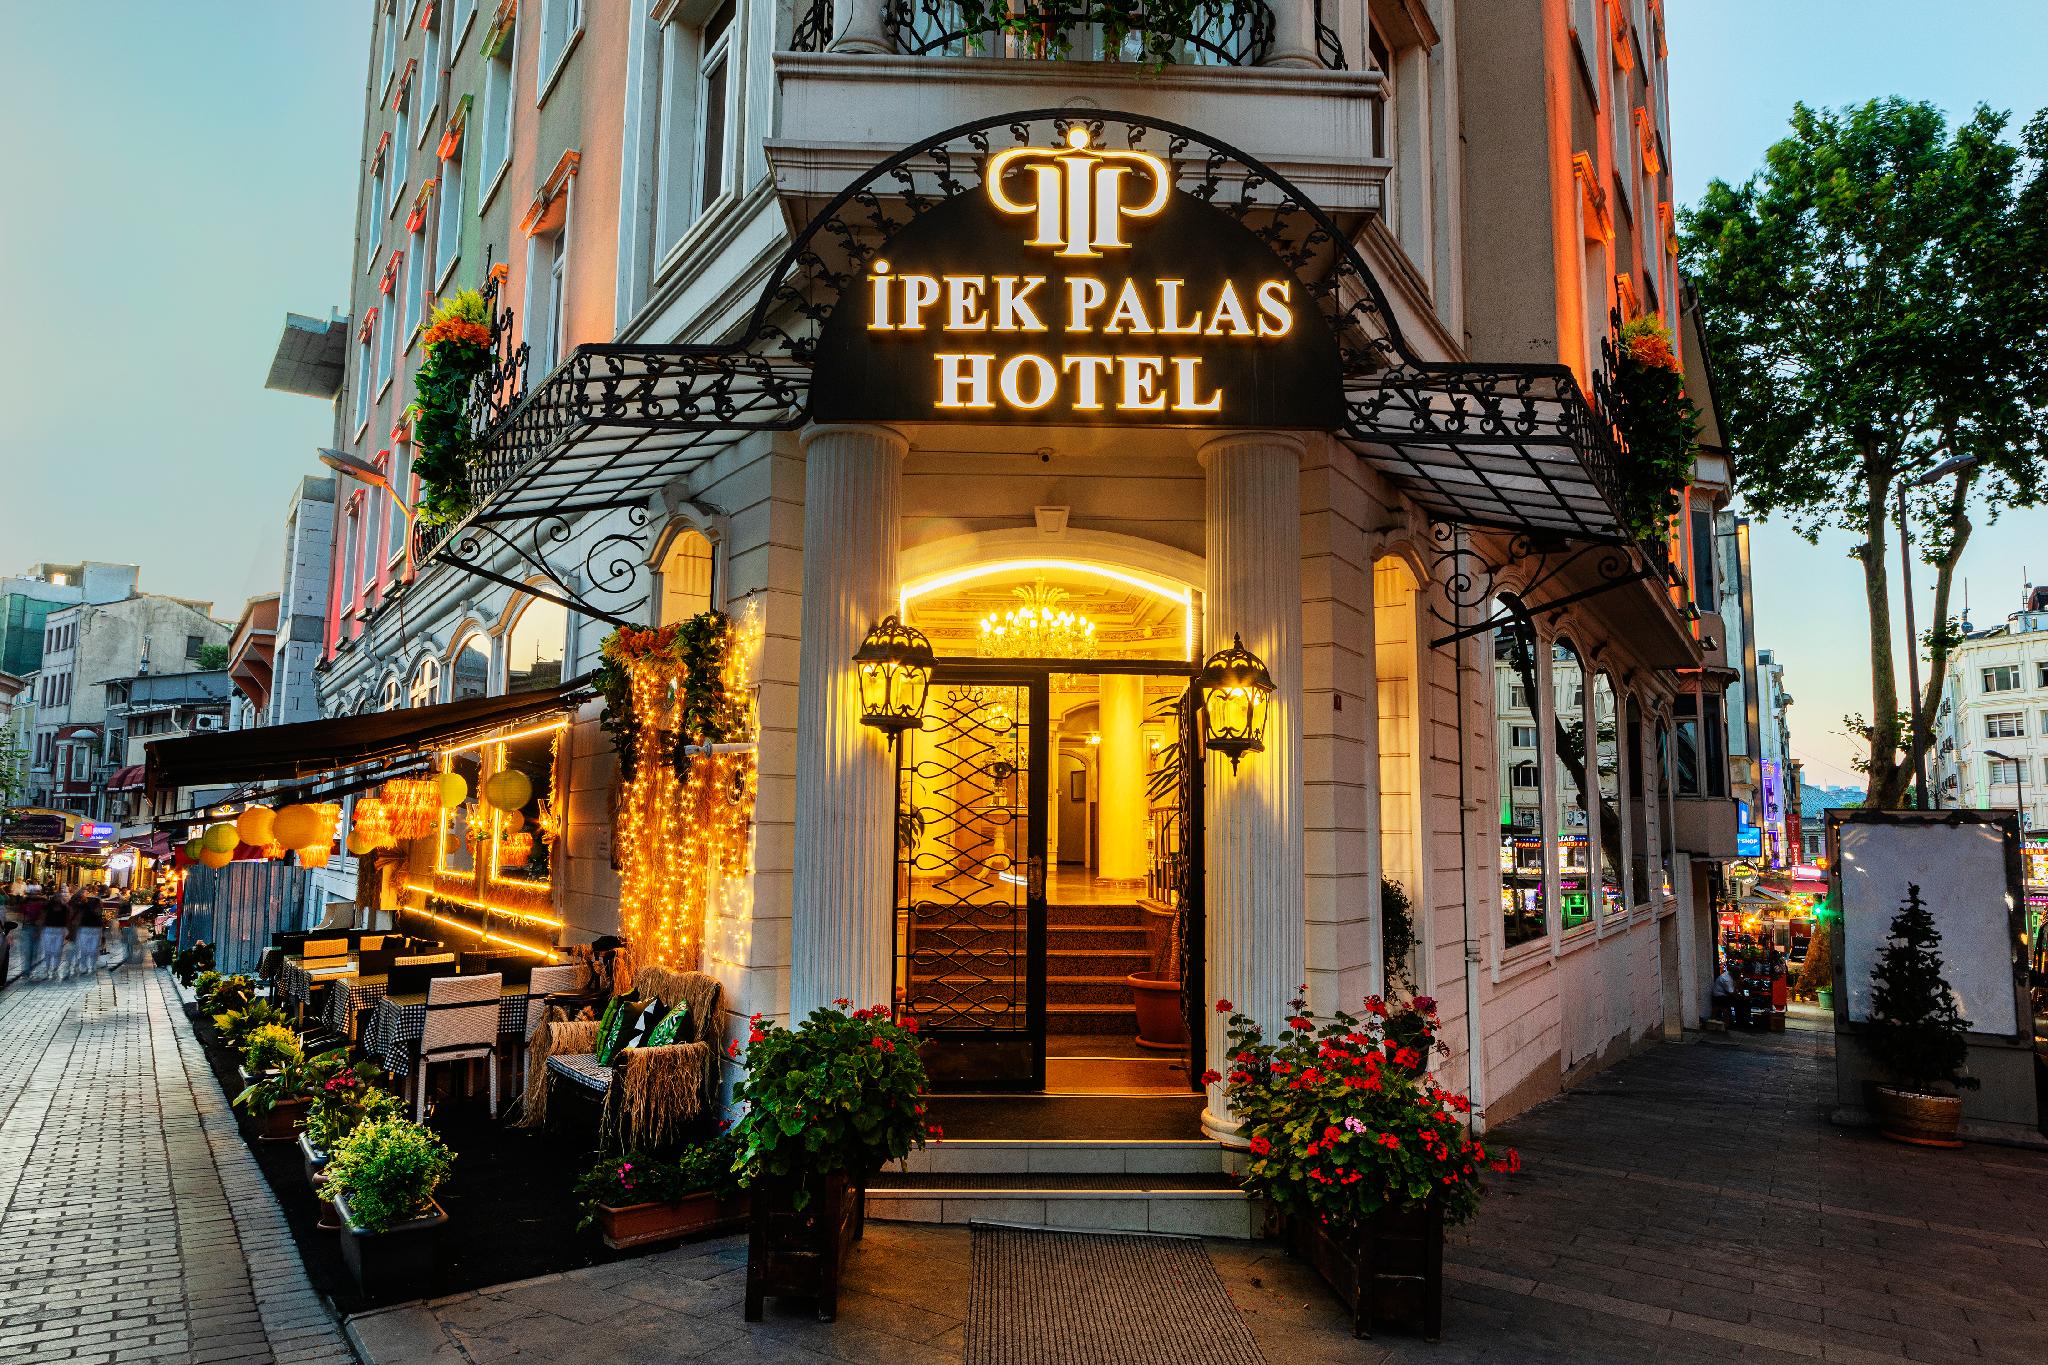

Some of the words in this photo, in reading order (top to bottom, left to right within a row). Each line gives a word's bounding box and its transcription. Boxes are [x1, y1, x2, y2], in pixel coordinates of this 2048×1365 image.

[866, 259, 1048, 332] İPEK
[1064, 276, 1294, 338] PALAS
[933, 353, 1223, 413] HOTEL
